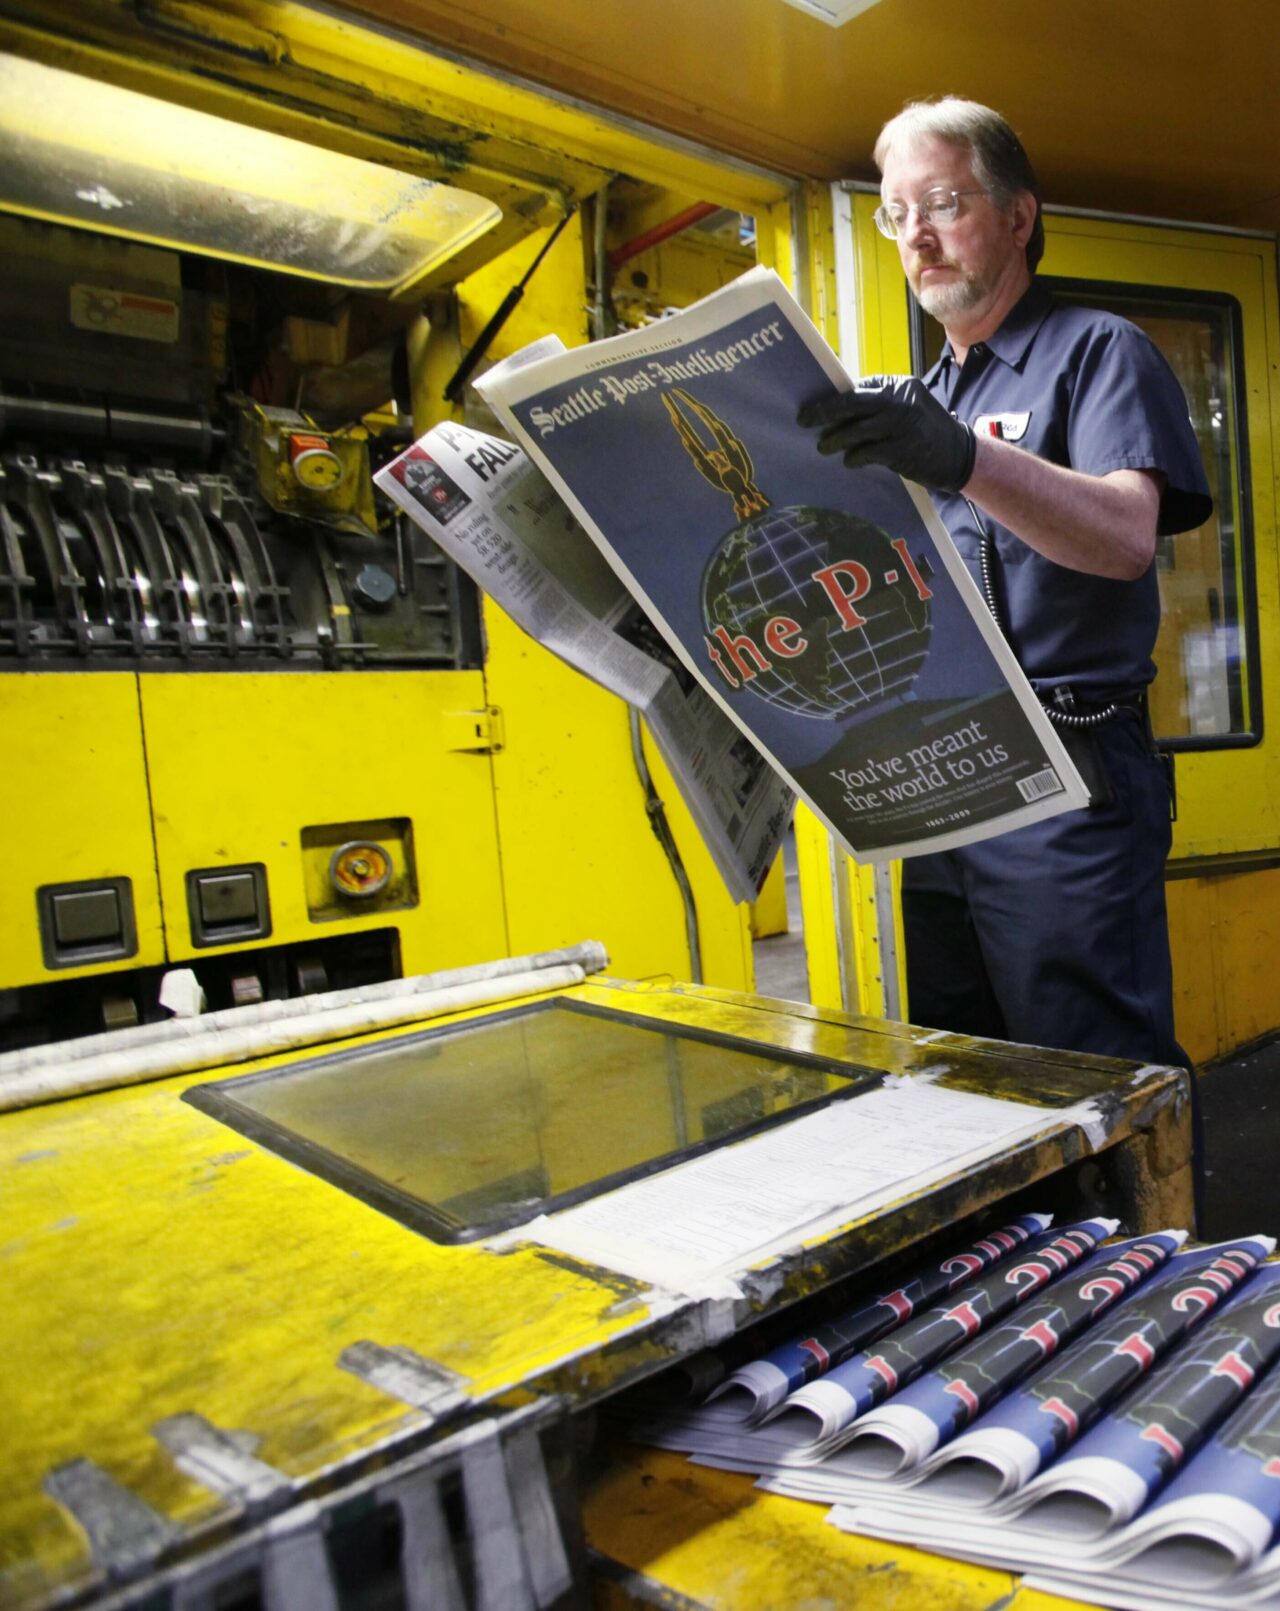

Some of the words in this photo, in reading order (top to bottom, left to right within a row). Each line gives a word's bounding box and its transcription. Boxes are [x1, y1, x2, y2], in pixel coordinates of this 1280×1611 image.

[530, 385, 607, 439] Seattle
[600, 321, 784, 405] Post-Intelligencer
[703, 616, 808, 688] the
[811, 537, 934, 632] P-I
[829, 758, 908, 791] You've
[906, 719, 988, 768] meant
[843, 790, 881, 812] the
[882, 766, 949, 804] world
[946, 761, 976, 781] to
[977, 744, 1009, 768] us
